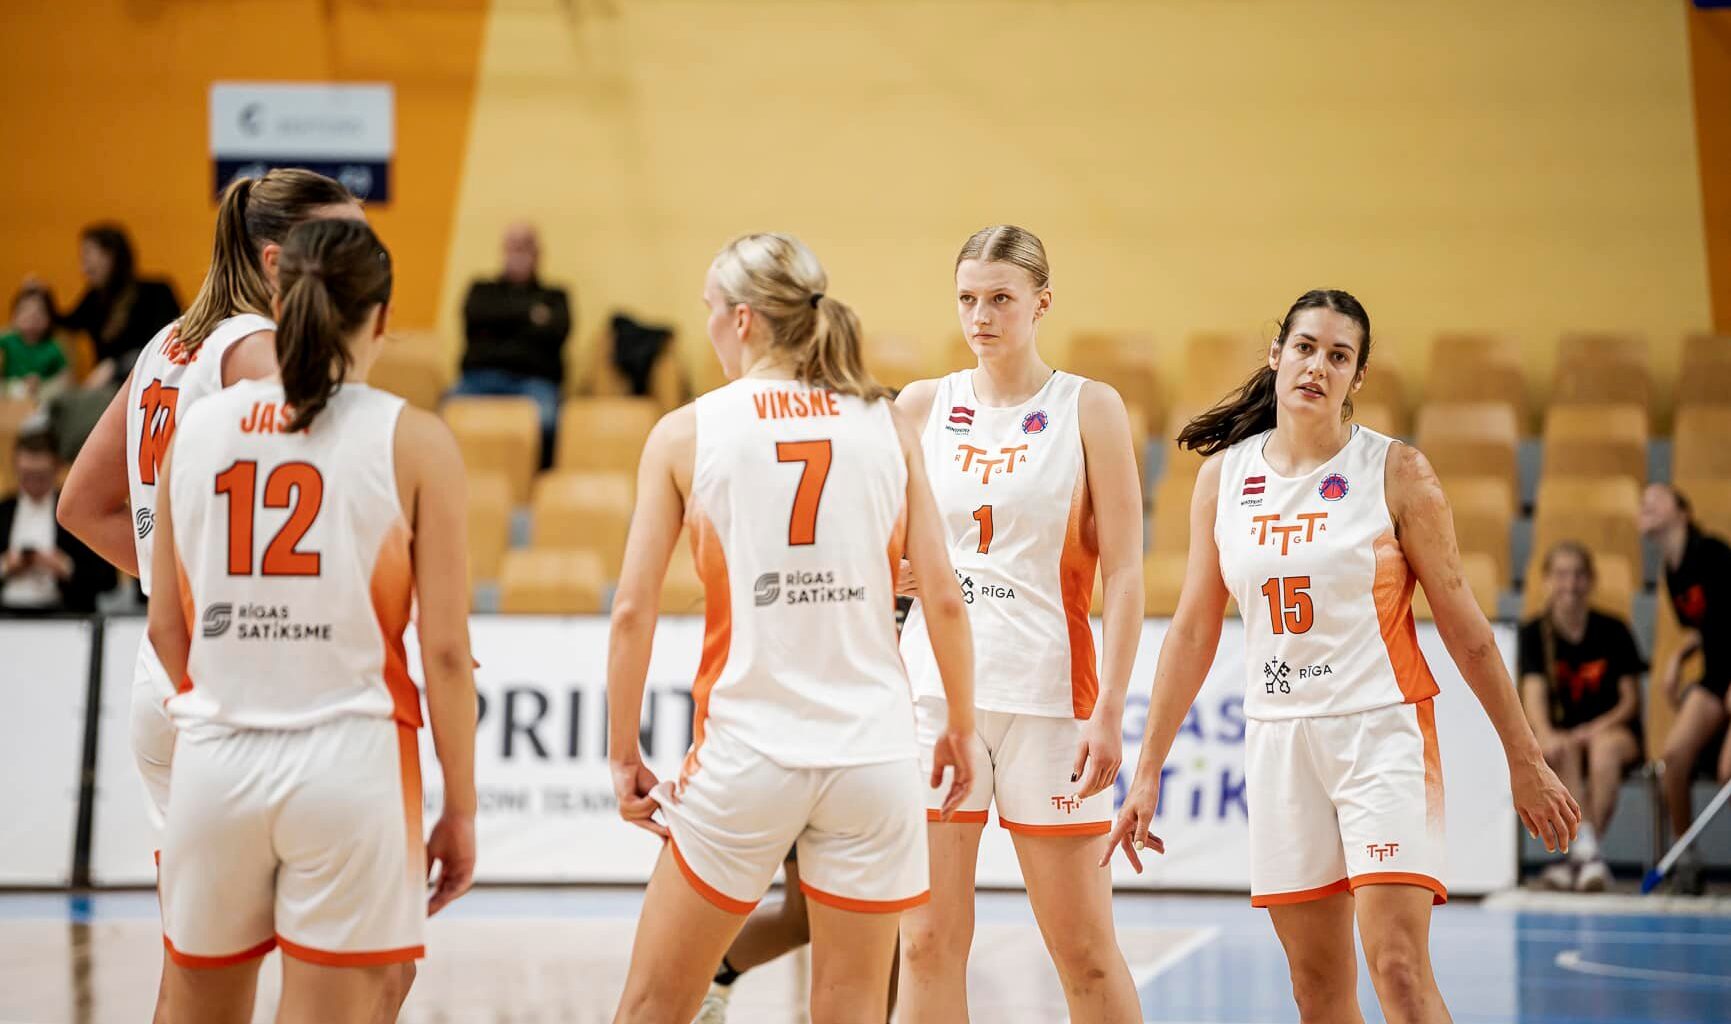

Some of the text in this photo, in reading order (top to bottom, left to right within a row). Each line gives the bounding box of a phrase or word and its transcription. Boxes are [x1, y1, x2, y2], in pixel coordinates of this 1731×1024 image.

[214, 460, 323, 577] 12
[776, 439, 832, 546] 7
[973, 504, 993, 554] 1
[981, 585, 1015, 599] RĪGA
[1261, 575, 1314, 635] 15
[1299, 664, 1332, 679] RĪGA
